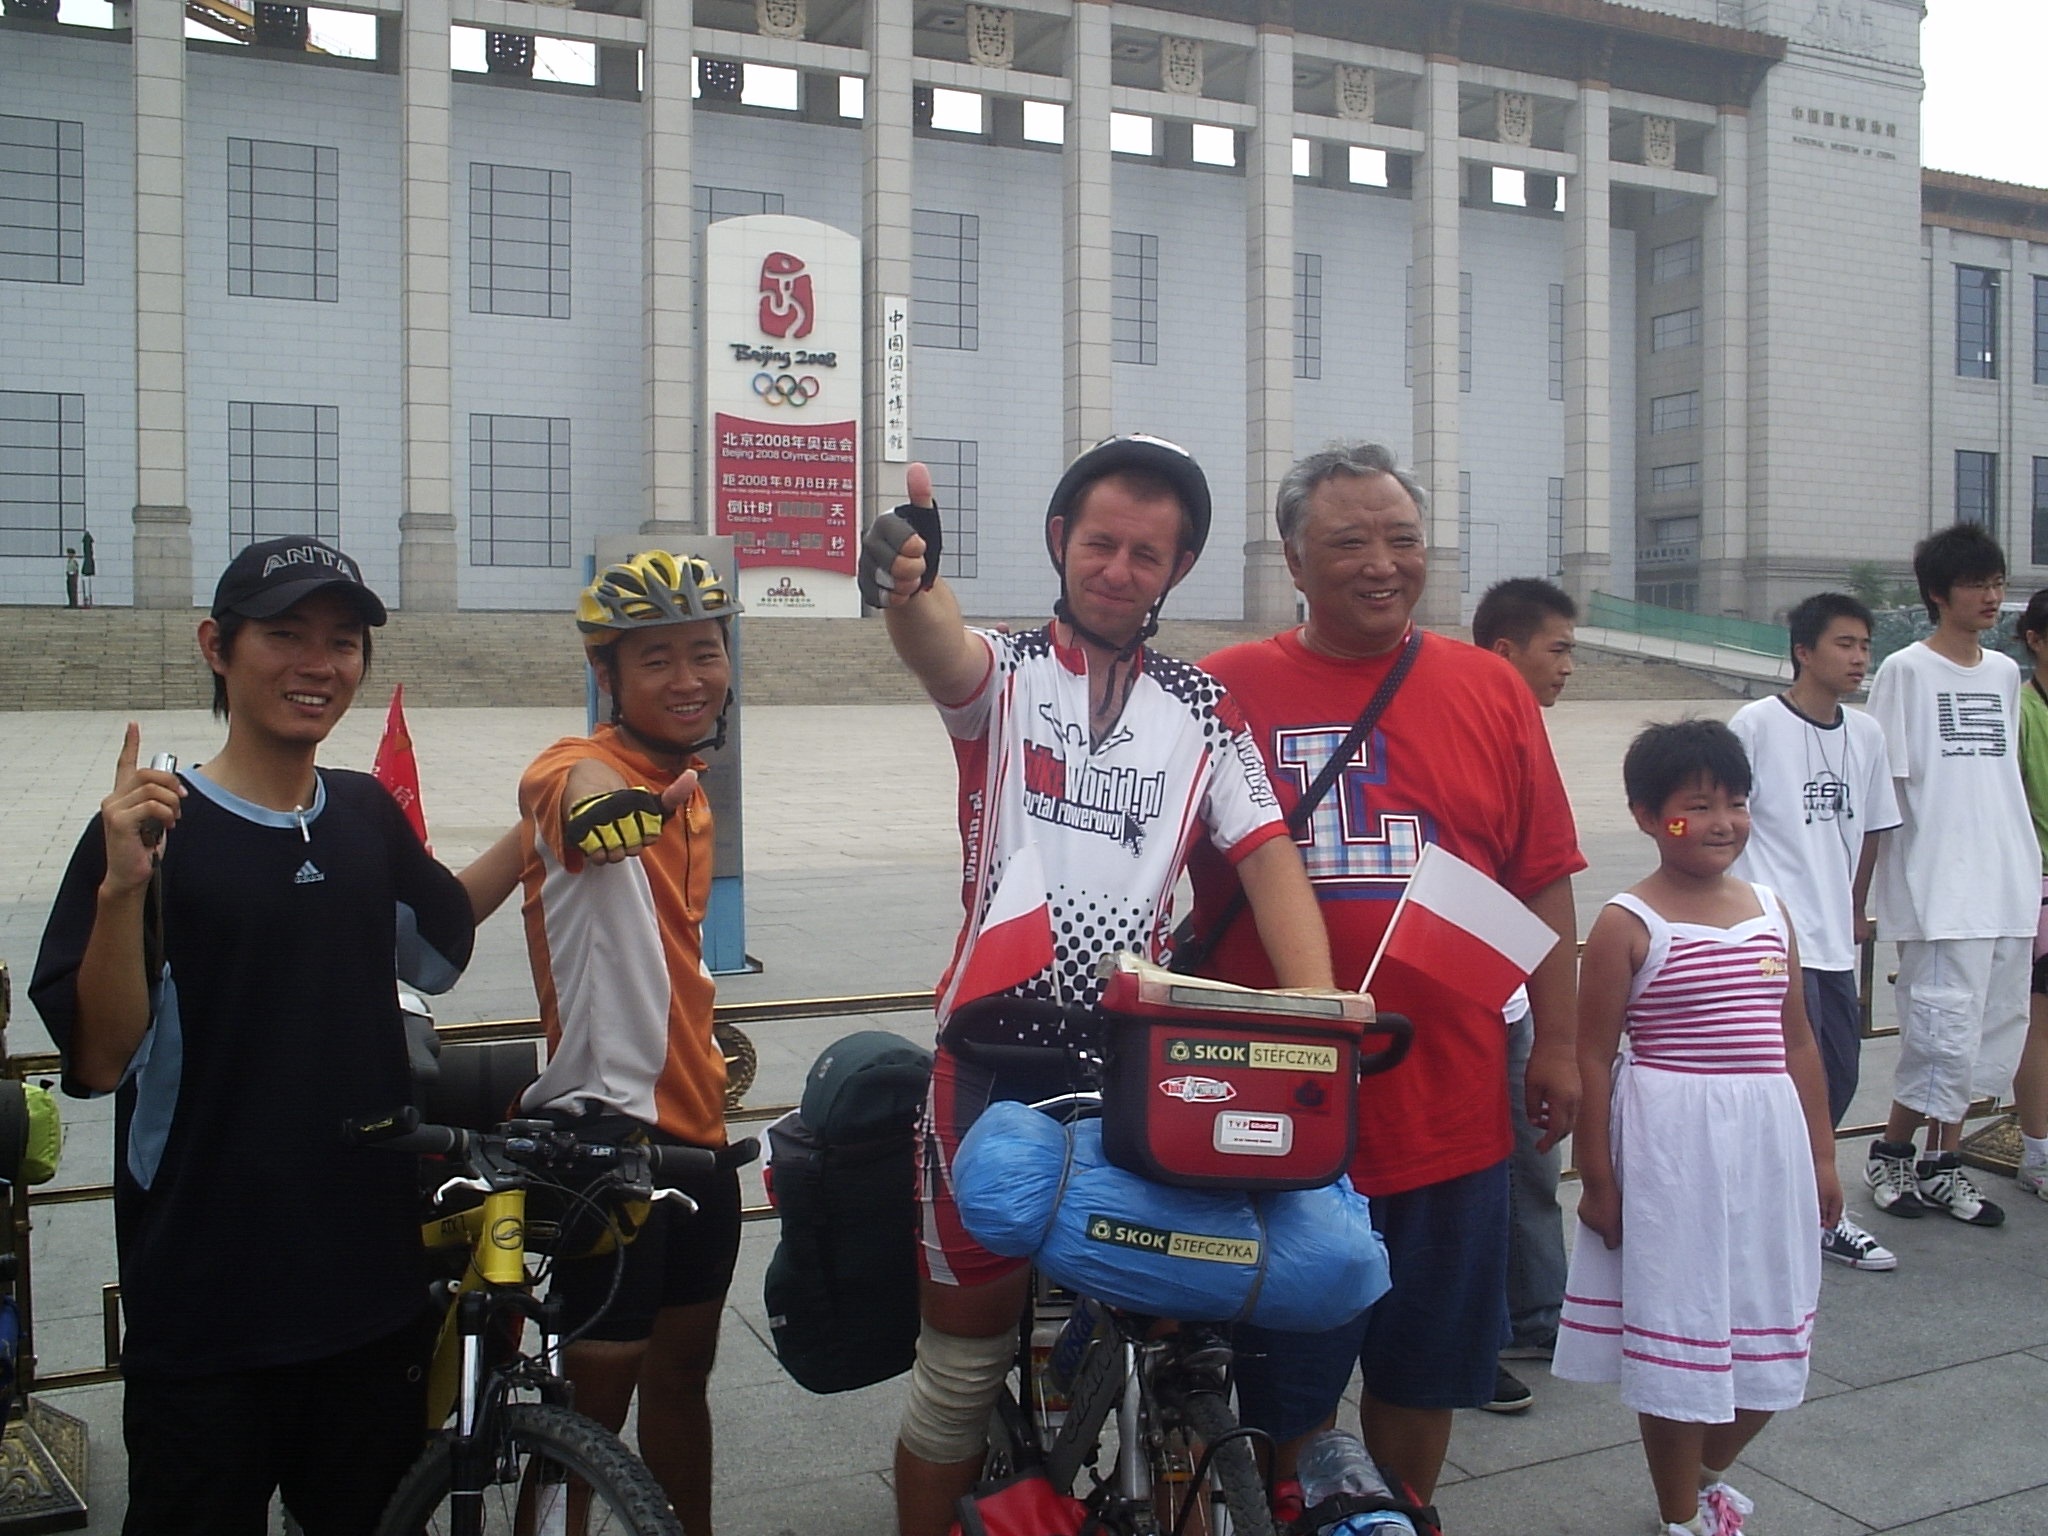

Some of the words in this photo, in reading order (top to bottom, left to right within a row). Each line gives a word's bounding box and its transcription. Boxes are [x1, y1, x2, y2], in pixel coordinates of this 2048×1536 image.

[729, 343, 792, 369] Beijing
[794, 350, 838, 368] 2008
[723, 432, 853, 451] 北京2008年奥运会
[722, 447, 754, 460] Beijing
[755, 449, 780, 460] 2008
[781, 450, 820, 462] Olympic
[820, 452, 854, 463] Games
[727, 500, 773, 515] 倒计时
[830, 503, 845, 518] 天
[727, 514, 773, 524] Countdown
[831, 536, 845, 550] 秒
[262, 546, 358, 583] ANTA
[767, 588, 806, 597] OMEGA
[1023, 790, 1056, 820] ortal
[1056, 801, 1123, 838] rowerowy
[1194, 1045, 1246, 1062] SKOK
[1254, 1048, 1333, 1066] STEFCZYKA
[1115, 1227, 1166, 1249] SKOK
[1173, 1238, 1253, 1259] STEFCZYKA
